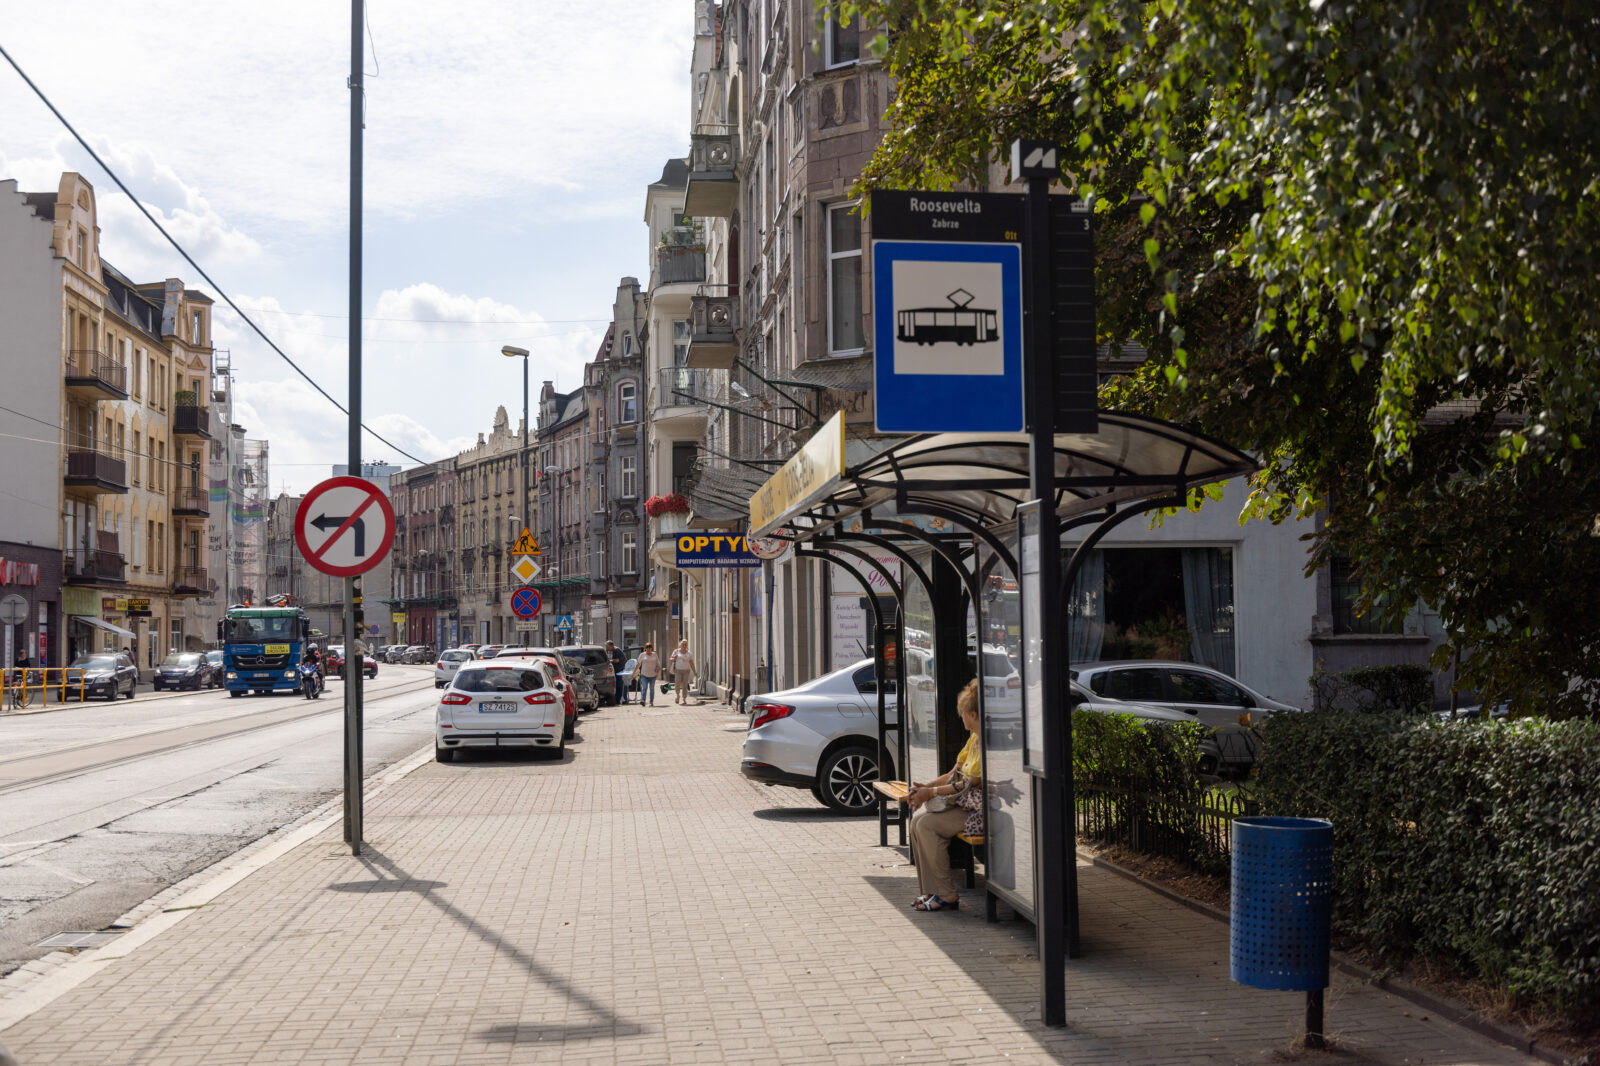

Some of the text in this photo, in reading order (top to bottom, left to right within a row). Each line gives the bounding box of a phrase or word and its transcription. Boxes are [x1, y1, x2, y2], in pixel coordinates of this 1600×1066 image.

[910, 197, 981, 214] Roosevelta
[932, 218, 959, 229] Zabrze
[1083, 218, 1090, 231] 3
[483, 703, 493, 711] SZ
